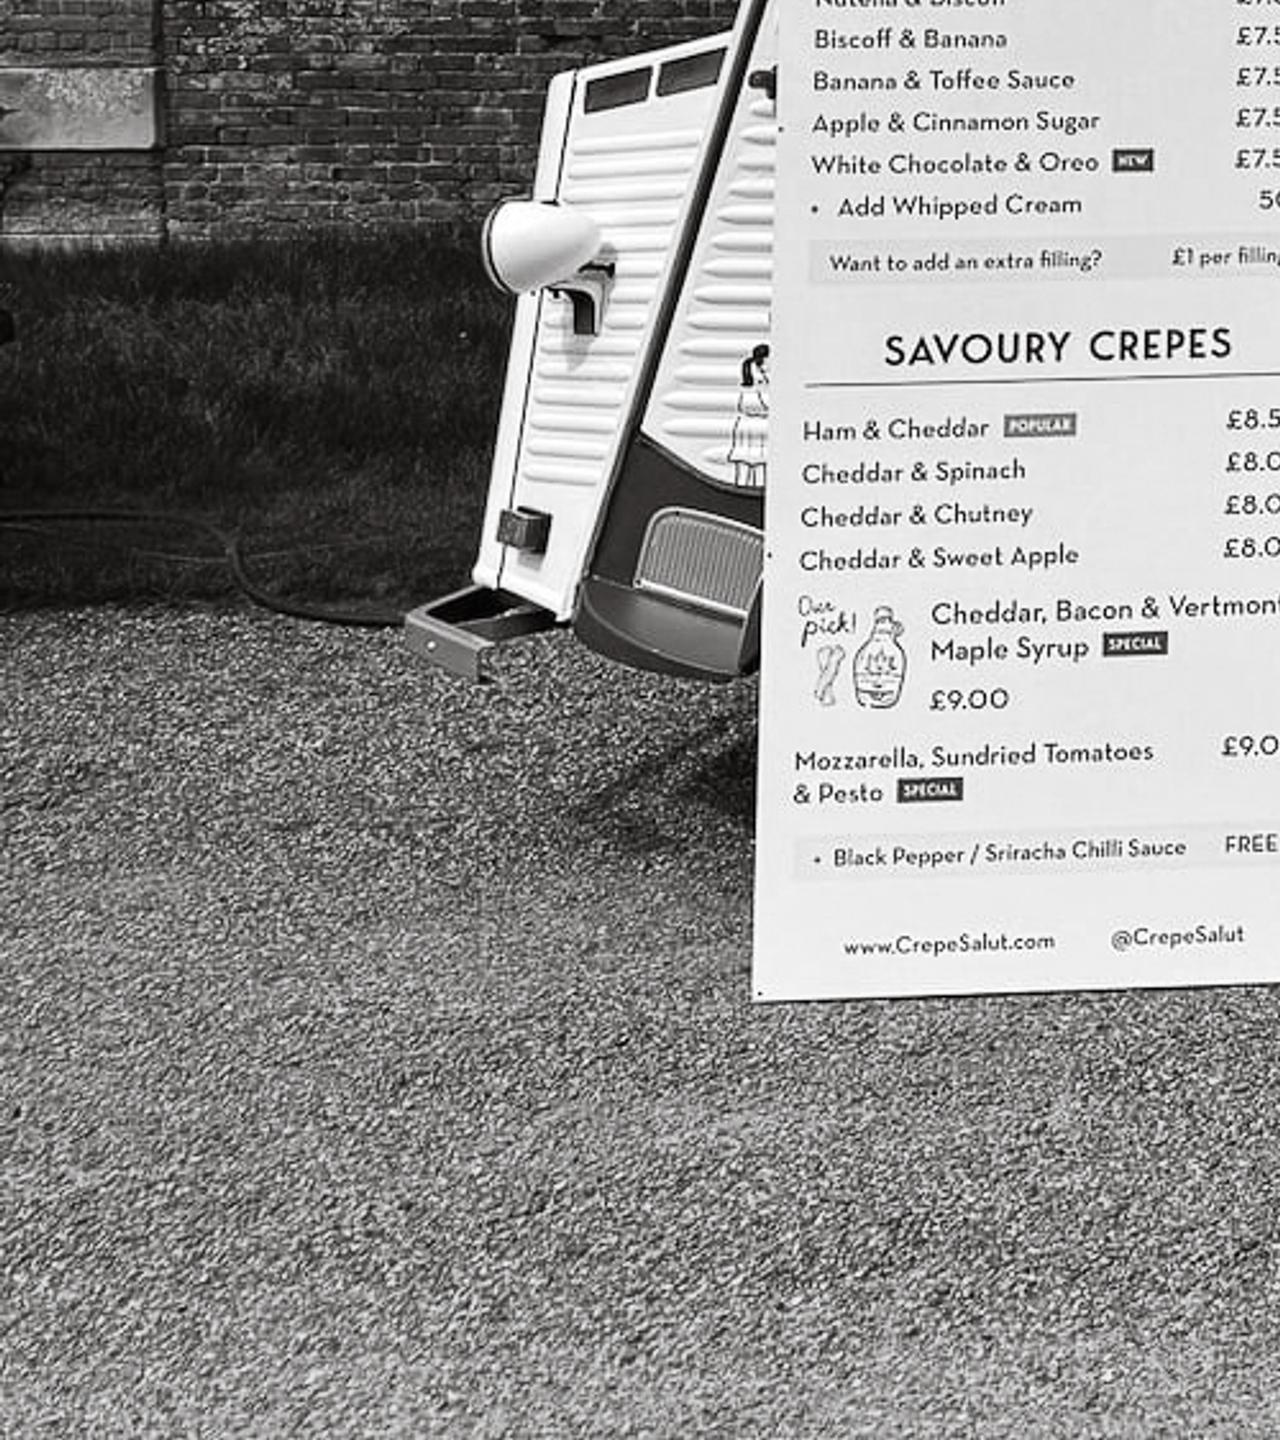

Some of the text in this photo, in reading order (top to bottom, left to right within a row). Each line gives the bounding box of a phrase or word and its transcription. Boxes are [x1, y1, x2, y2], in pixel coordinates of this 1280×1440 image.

[815, 27, 1007, 48] Biscoff & Banana
[814, 68, 1075, 91] Banana & Toffee Sauce
[812, 111, 1100, 138] Apple & Cinnamon Sugar
[812, 152, 1099, 174] White Chocolate & Oreo
[838, 193, 1081, 220] Add Whipped Cream
[830, 249, 1102, 272] Want to add an extra filling?
[1172, 247, 1193, 266] £1
[1200, 253, 1232, 269] per
[885, 328, 1231, 366] SAVOURY CREPES
[804, 416, 989, 440] Ham & Cheddar
[802, 458, 1025, 486] Cheddar & Spinach
[801, 502, 1033, 527] Cheddar & Chutney
[799, 542, 1079, 571] Cheddar & Sweet Apple
[932, 600, 1047, 625] Cheddar,
[1057, 600, 1132, 622] Bacon
[1142, 596, 1160, 619] &
[932, 636, 1008, 666] Maple
[1017, 636, 1089, 665] Syrup
[1107, 636, 1163, 653] SPECIAL
[930, 688, 1009, 711] £9.00
[796, 742, 1153, 771] Mozzarella, Sundried Tomatoes
[793, 783, 883, 804] & Pesto
[834, 839, 1186, 868] Black Pepper / Sriracha Chilli Sauce
[1226, 834, 1277, 852] FREE
[845, 933, 1055, 957] www.CrepeSalut.com
[1112, 925, 1243, 952] @CrepeSalut
